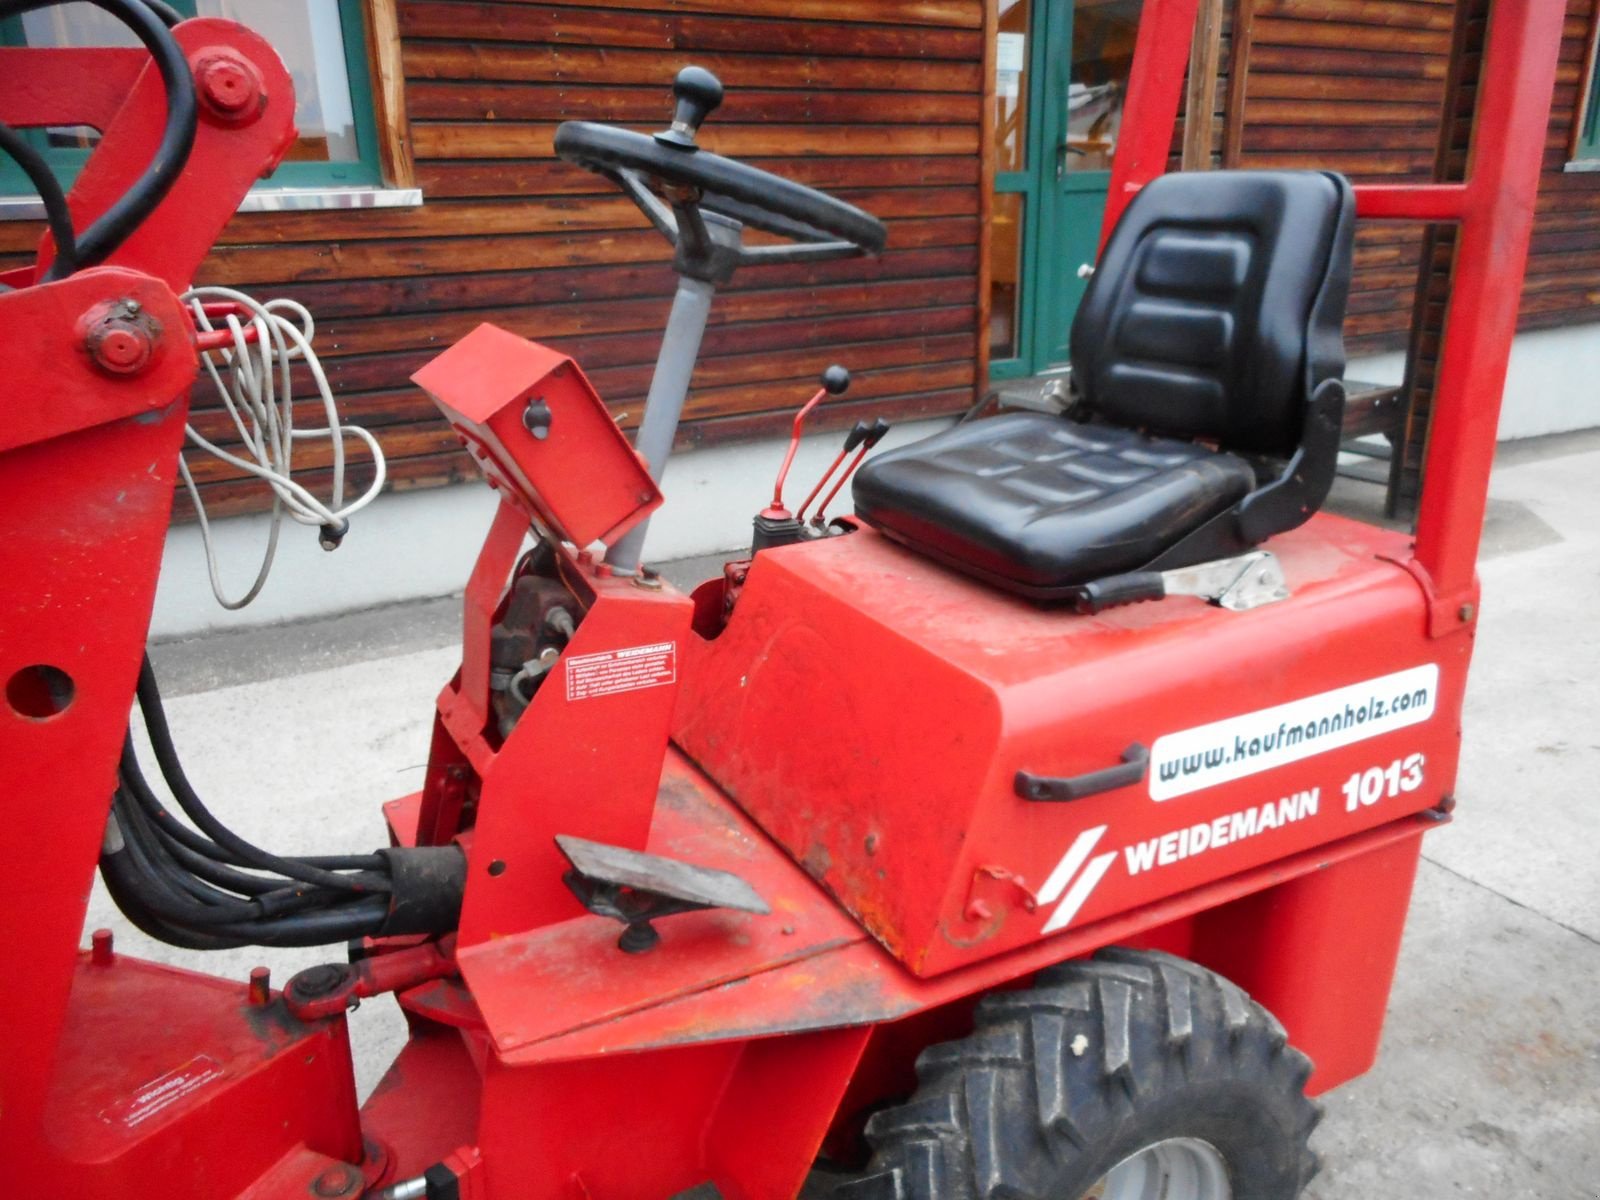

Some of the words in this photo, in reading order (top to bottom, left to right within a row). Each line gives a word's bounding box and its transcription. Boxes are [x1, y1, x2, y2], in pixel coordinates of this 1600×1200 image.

[616, 644, 672, 658] WEIDEMANN
[1159, 687, 1428, 782] www.kaufmannholz.com
[1124, 788, 1320, 877] WEIDEMANN
[1342, 752, 1425, 812] 1013
